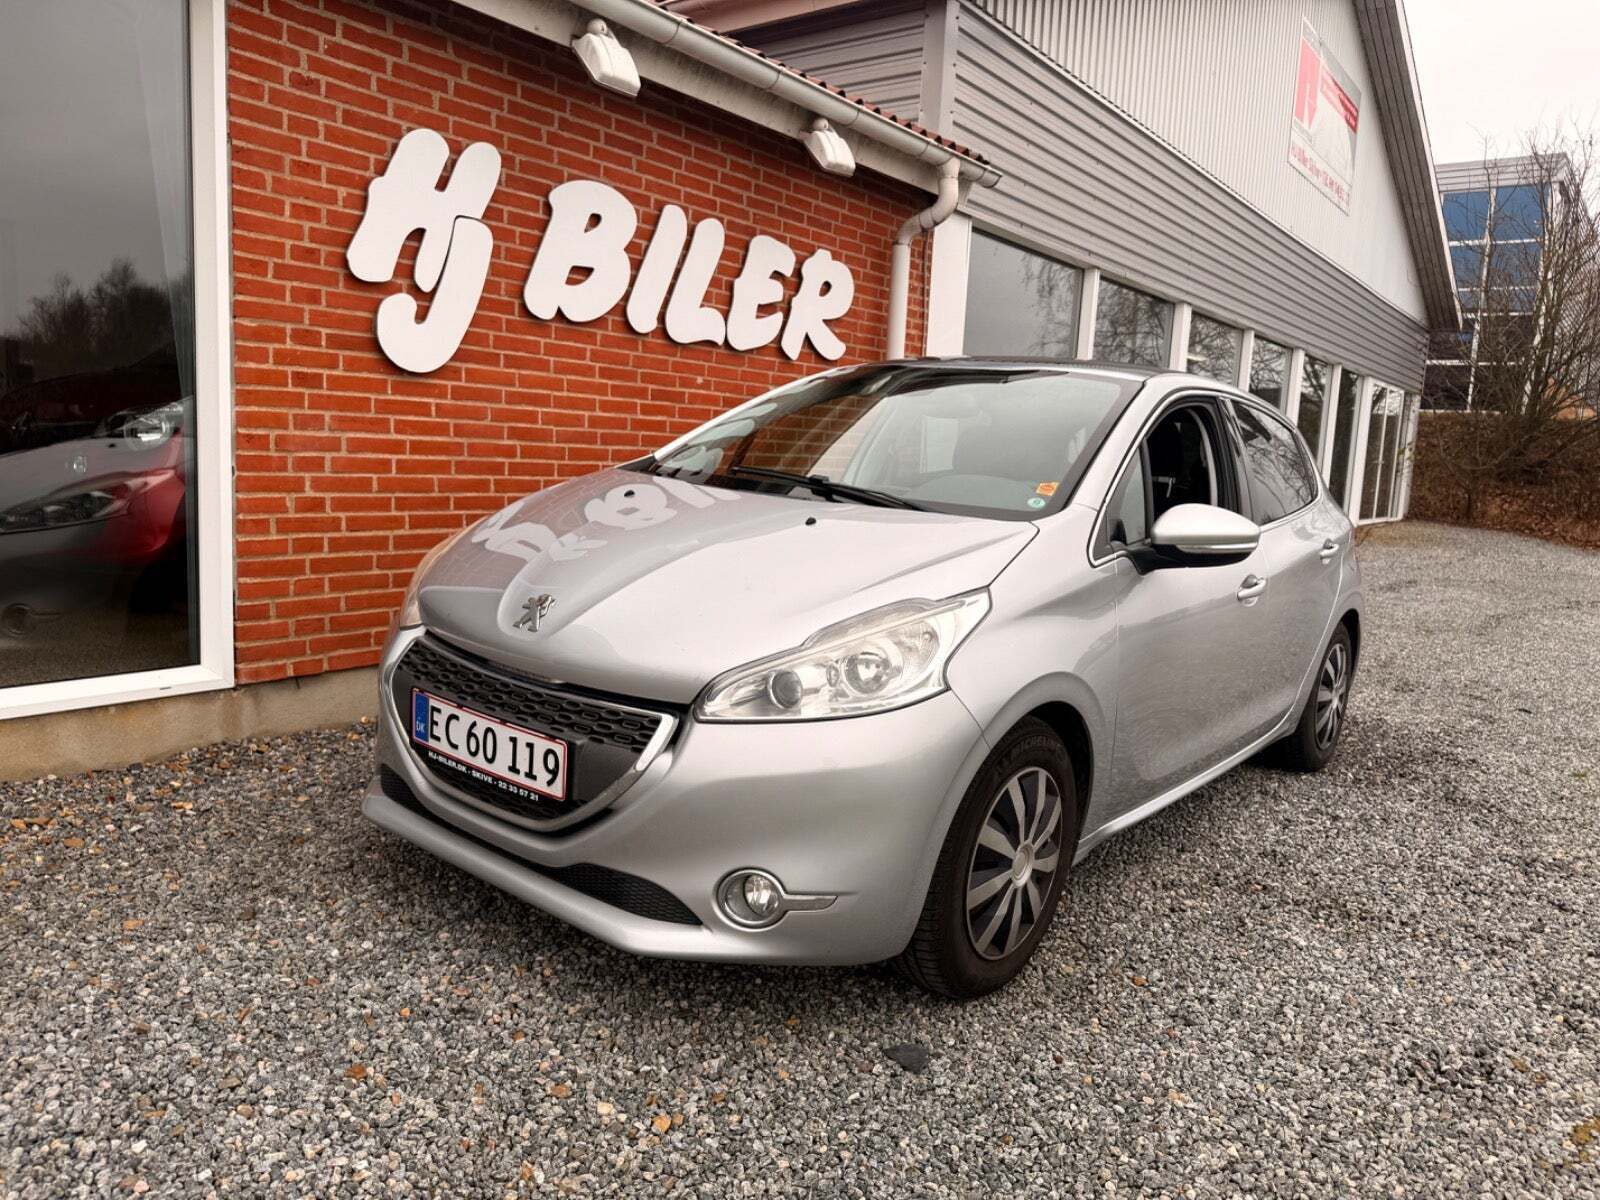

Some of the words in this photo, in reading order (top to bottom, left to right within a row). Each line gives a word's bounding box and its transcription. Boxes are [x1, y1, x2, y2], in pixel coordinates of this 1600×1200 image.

[346, 128, 501, 373] HJ
[524, 180, 855, 361] BILER
[416, 720, 425, 733] DK
[430, 705, 460, 750] EC
[466, 720, 497, 764] 60
[508, 736, 560, 787] 119
[472, 770, 493, 784] SKIVE
